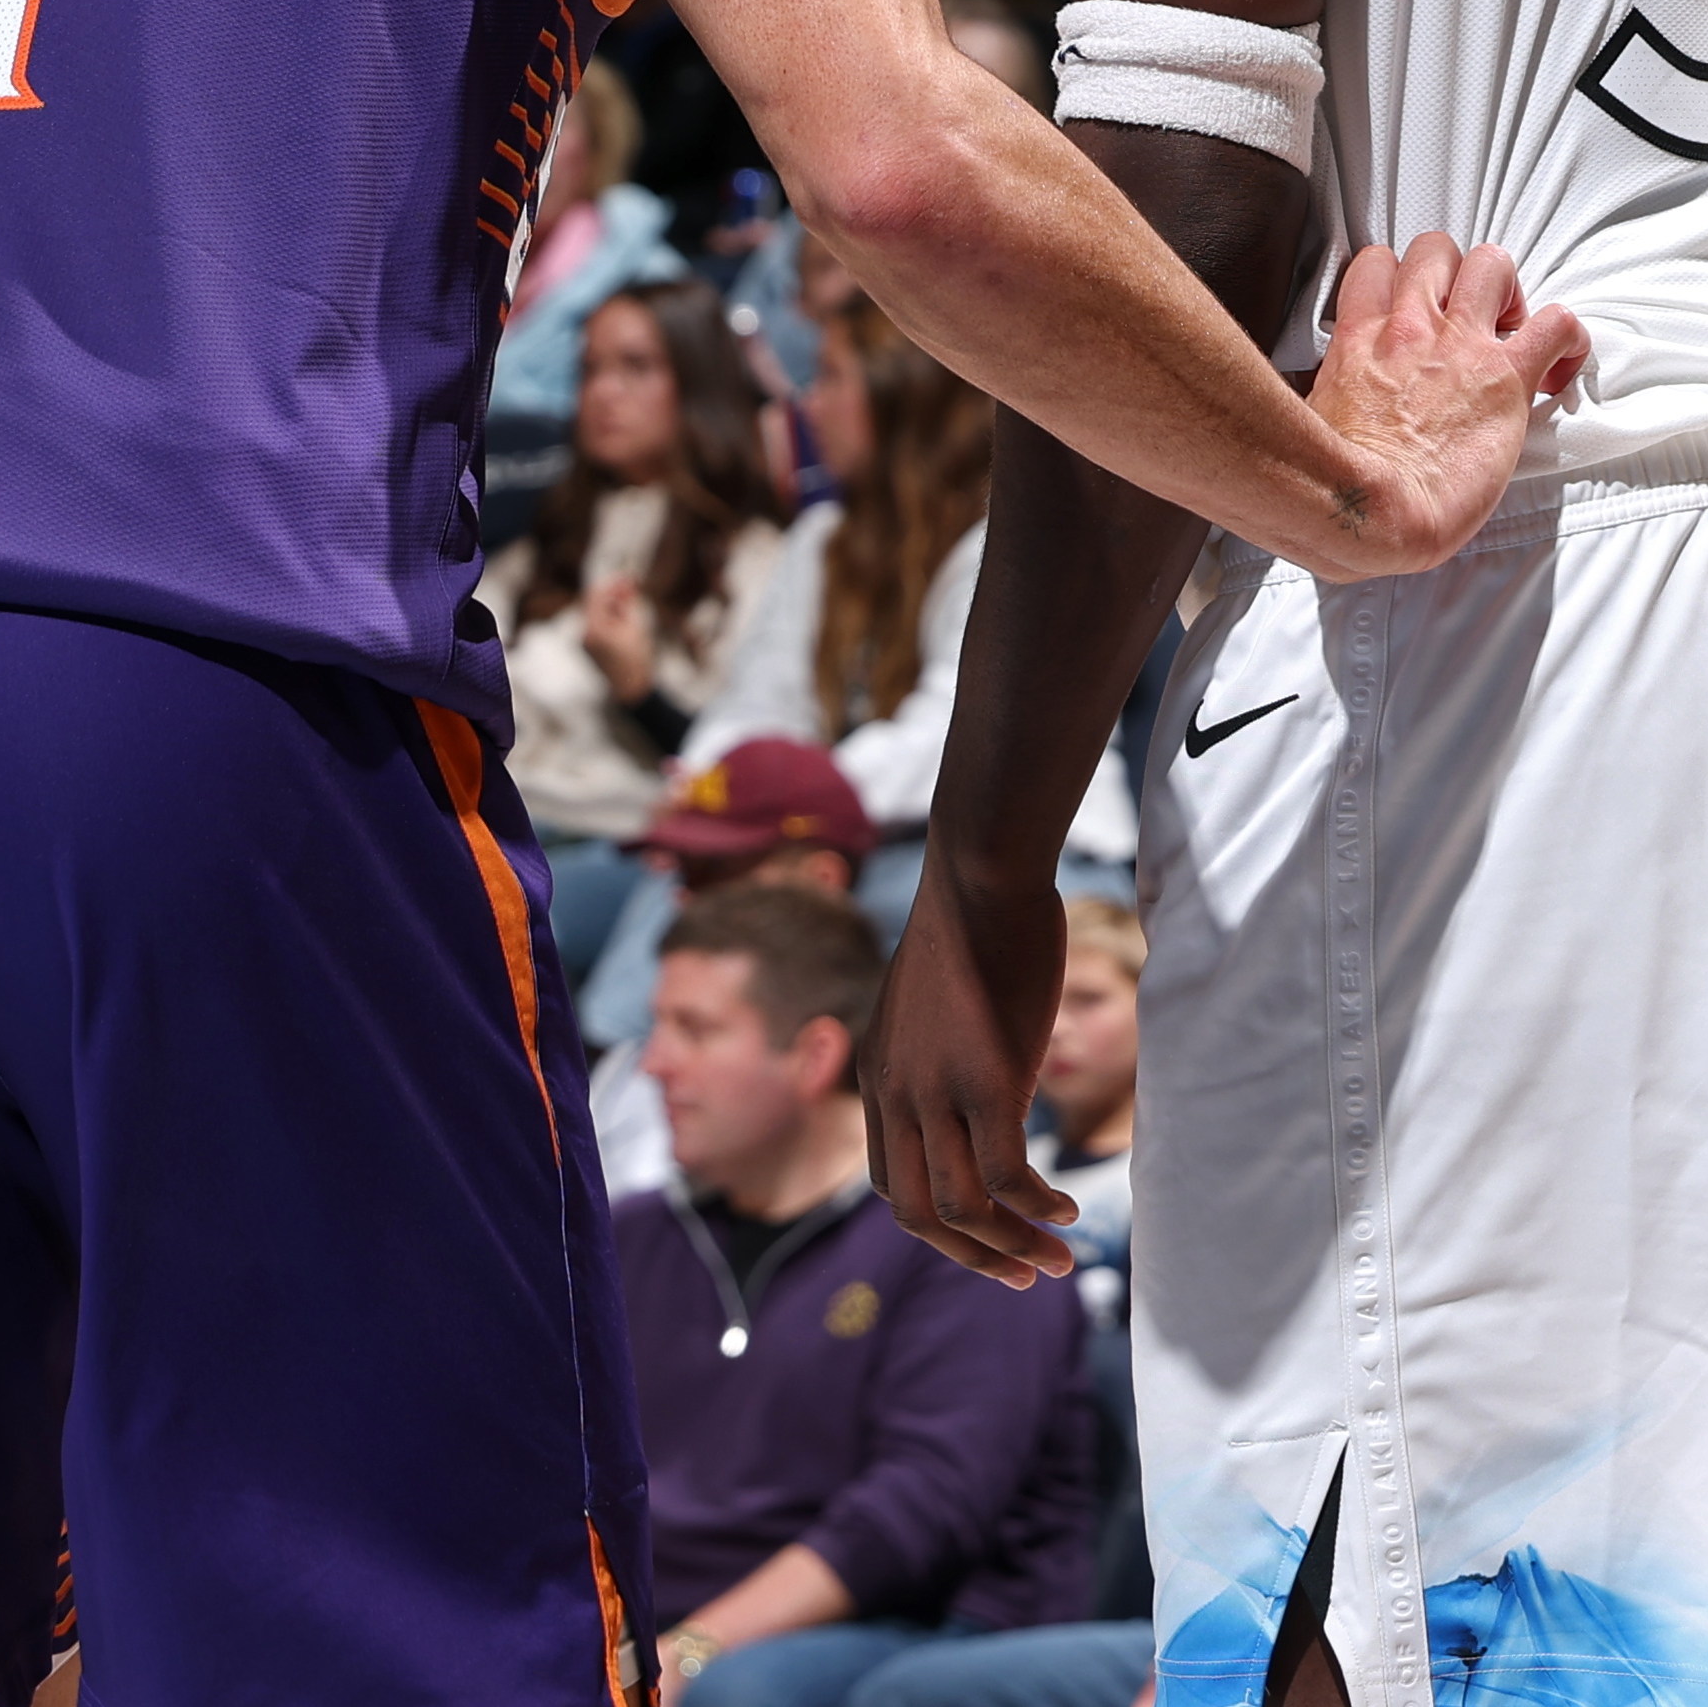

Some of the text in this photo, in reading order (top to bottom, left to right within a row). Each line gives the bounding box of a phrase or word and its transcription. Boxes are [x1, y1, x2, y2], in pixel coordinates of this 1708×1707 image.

[1348, 609, 1377, 720] 10,000
[1335, 788, 1361, 884] LAND
[1339, 950, 1365, 1062] LAKES
[1342, 1074, 1373, 1185] 10,000
[1353, 1252, 1381, 1342] LAND
[1364, 1409, 1401, 1513] LAKES
[1381, 1521, 1417, 1634] 10,000
